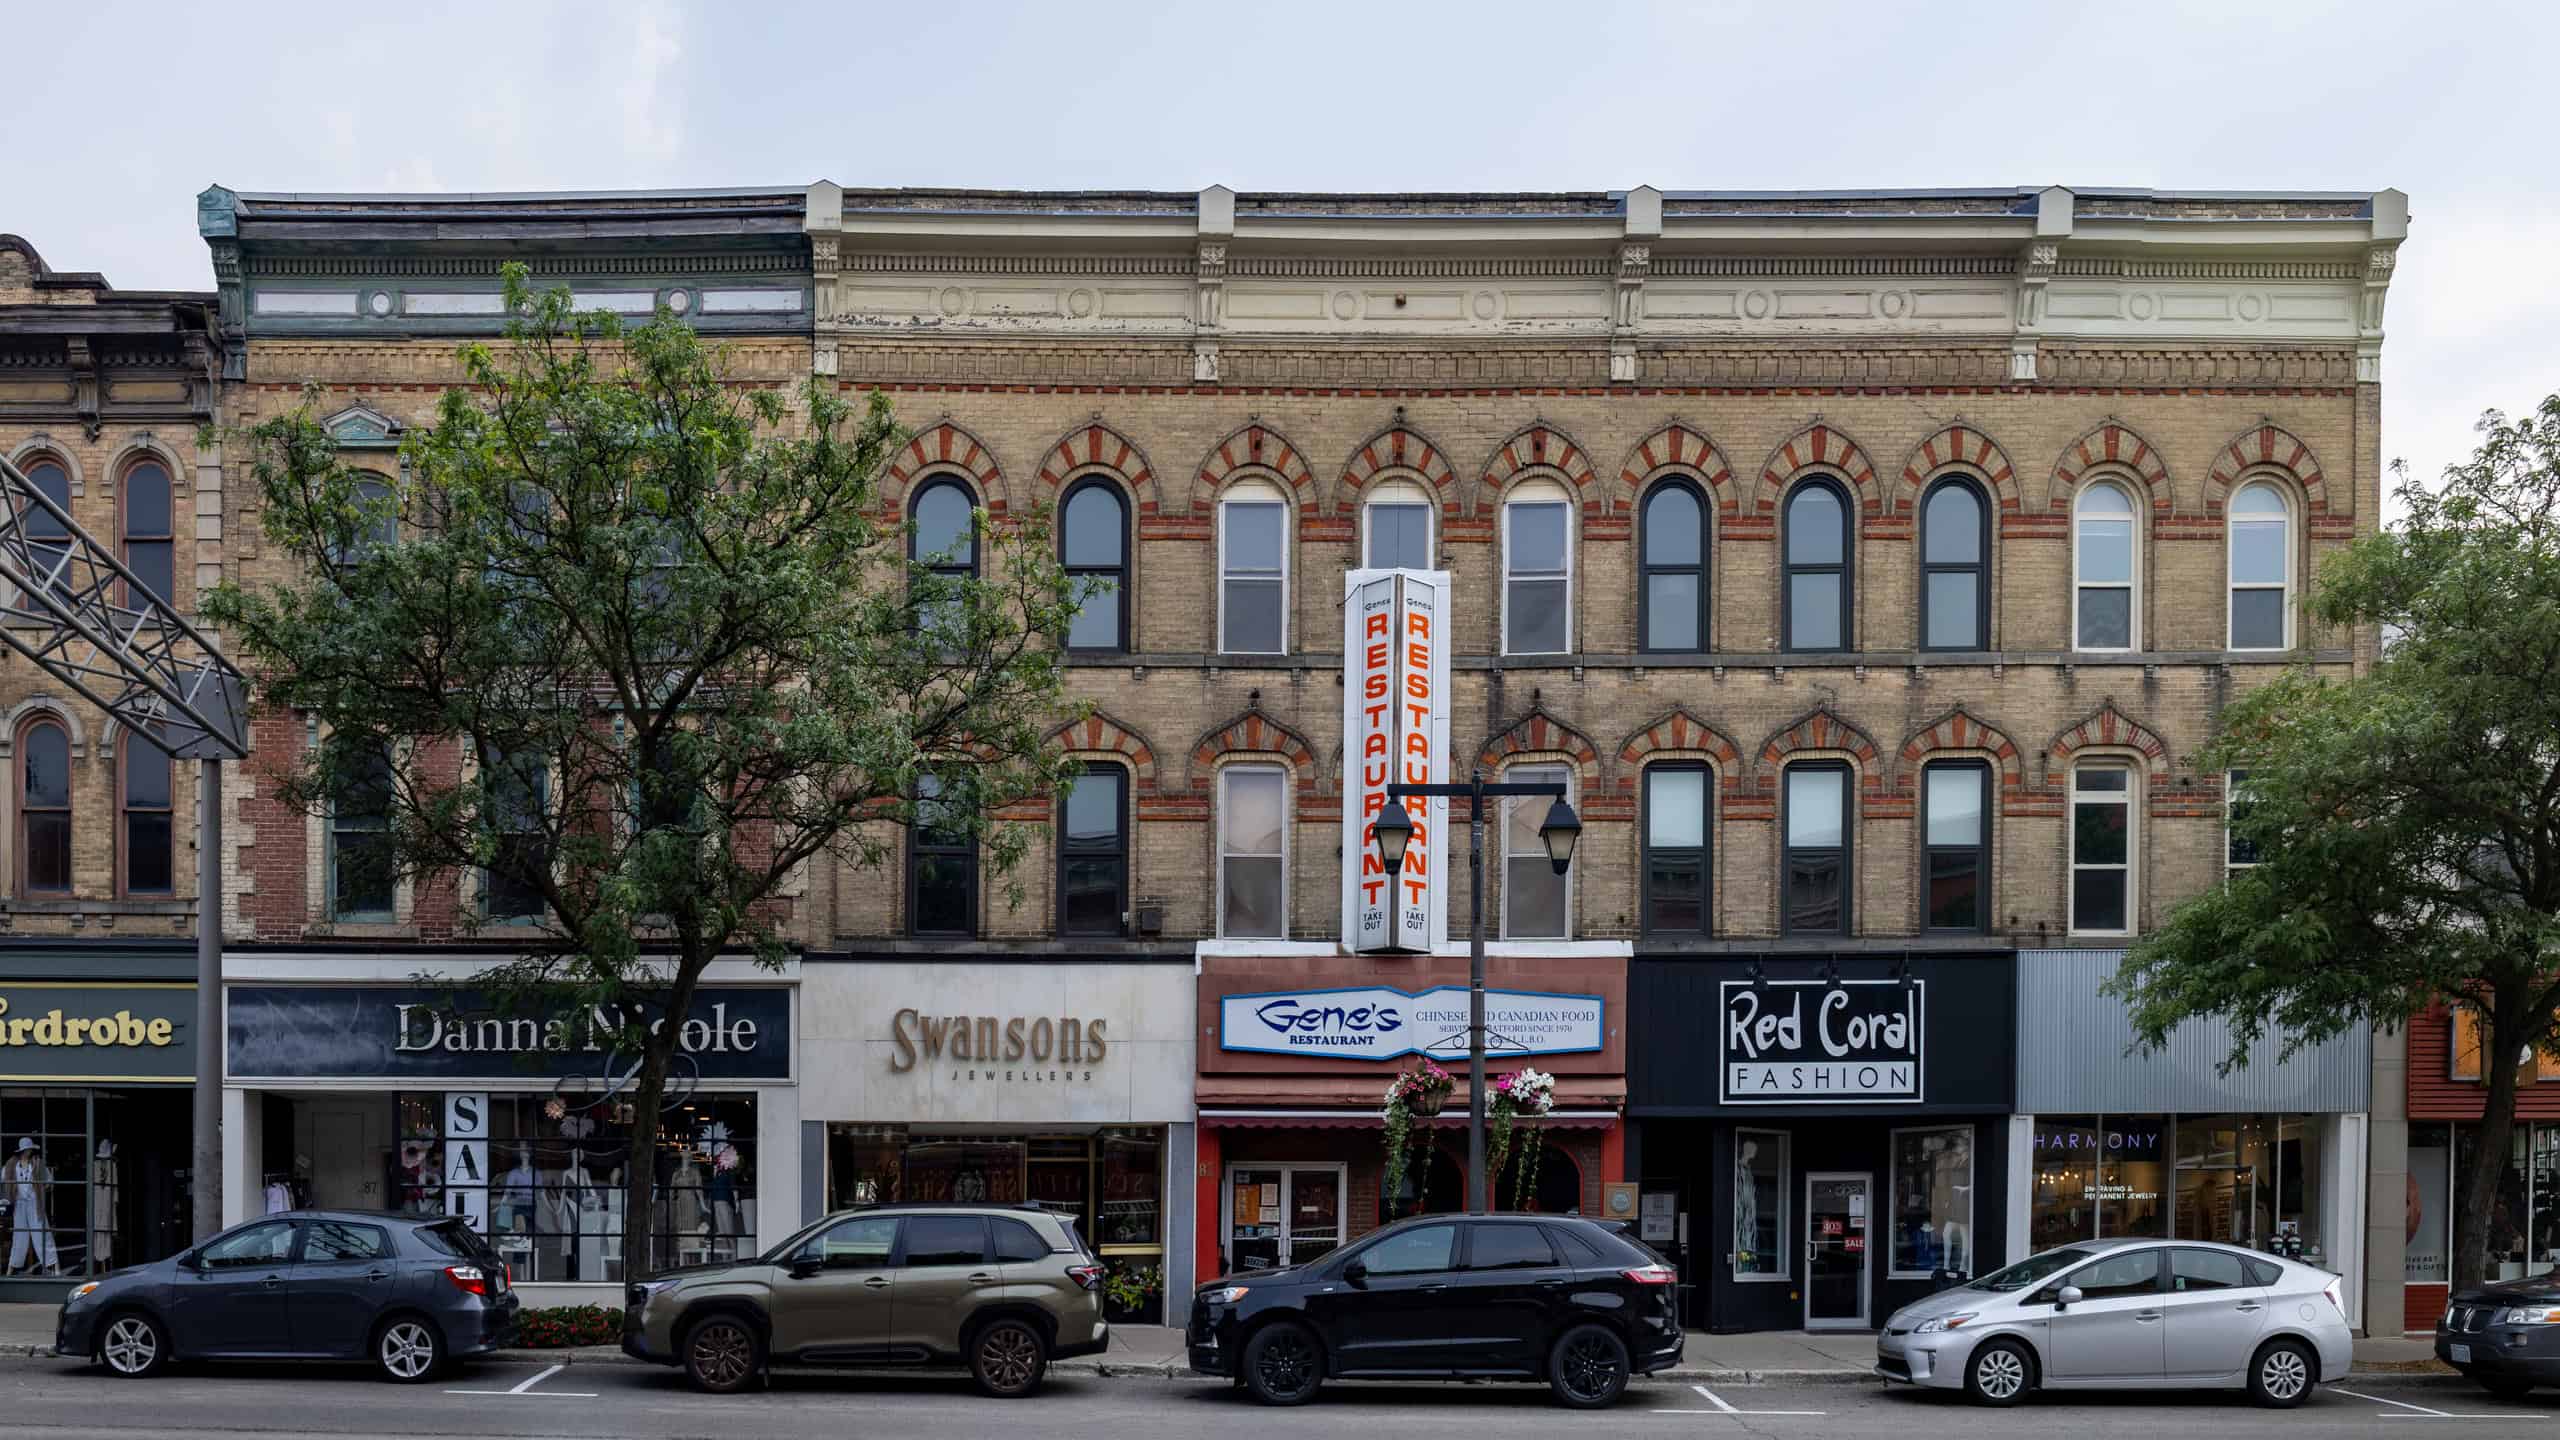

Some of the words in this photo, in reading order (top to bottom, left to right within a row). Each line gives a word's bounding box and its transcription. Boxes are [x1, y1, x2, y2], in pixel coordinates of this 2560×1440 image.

[1363, 912, 1383, 921] TAKE
[1406, 912, 1425, 921] TAKE
[1364, 921, 1380, 930] OUT
[1407, 921, 1423, 930] OUT
[1255, 1000, 1402, 1032] Gene's
[1416, 1010, 1469, 1021] CHINESE
[1498, 1010, 1558, 1021] CANADIAN
[1562, 1010, 1595, 1021] FOOD
[394, 1003, 570, 1051] Danna
[1730, 991, 1801, 1058] Red
[1819, 990, 1916, 1057] Coral
[892, 1008, 1107, 1073] Swansons
[1290, 1035, 1375, 1045] RESTAURANT
[952, 1070, 1092, 1081] JEWELLERS
[1737, 1068, 1909, 1088] FASHION
[2034, 1133, 2158, 1149] HARMONY
[1844, 1240, 1864, 1248] SALE
